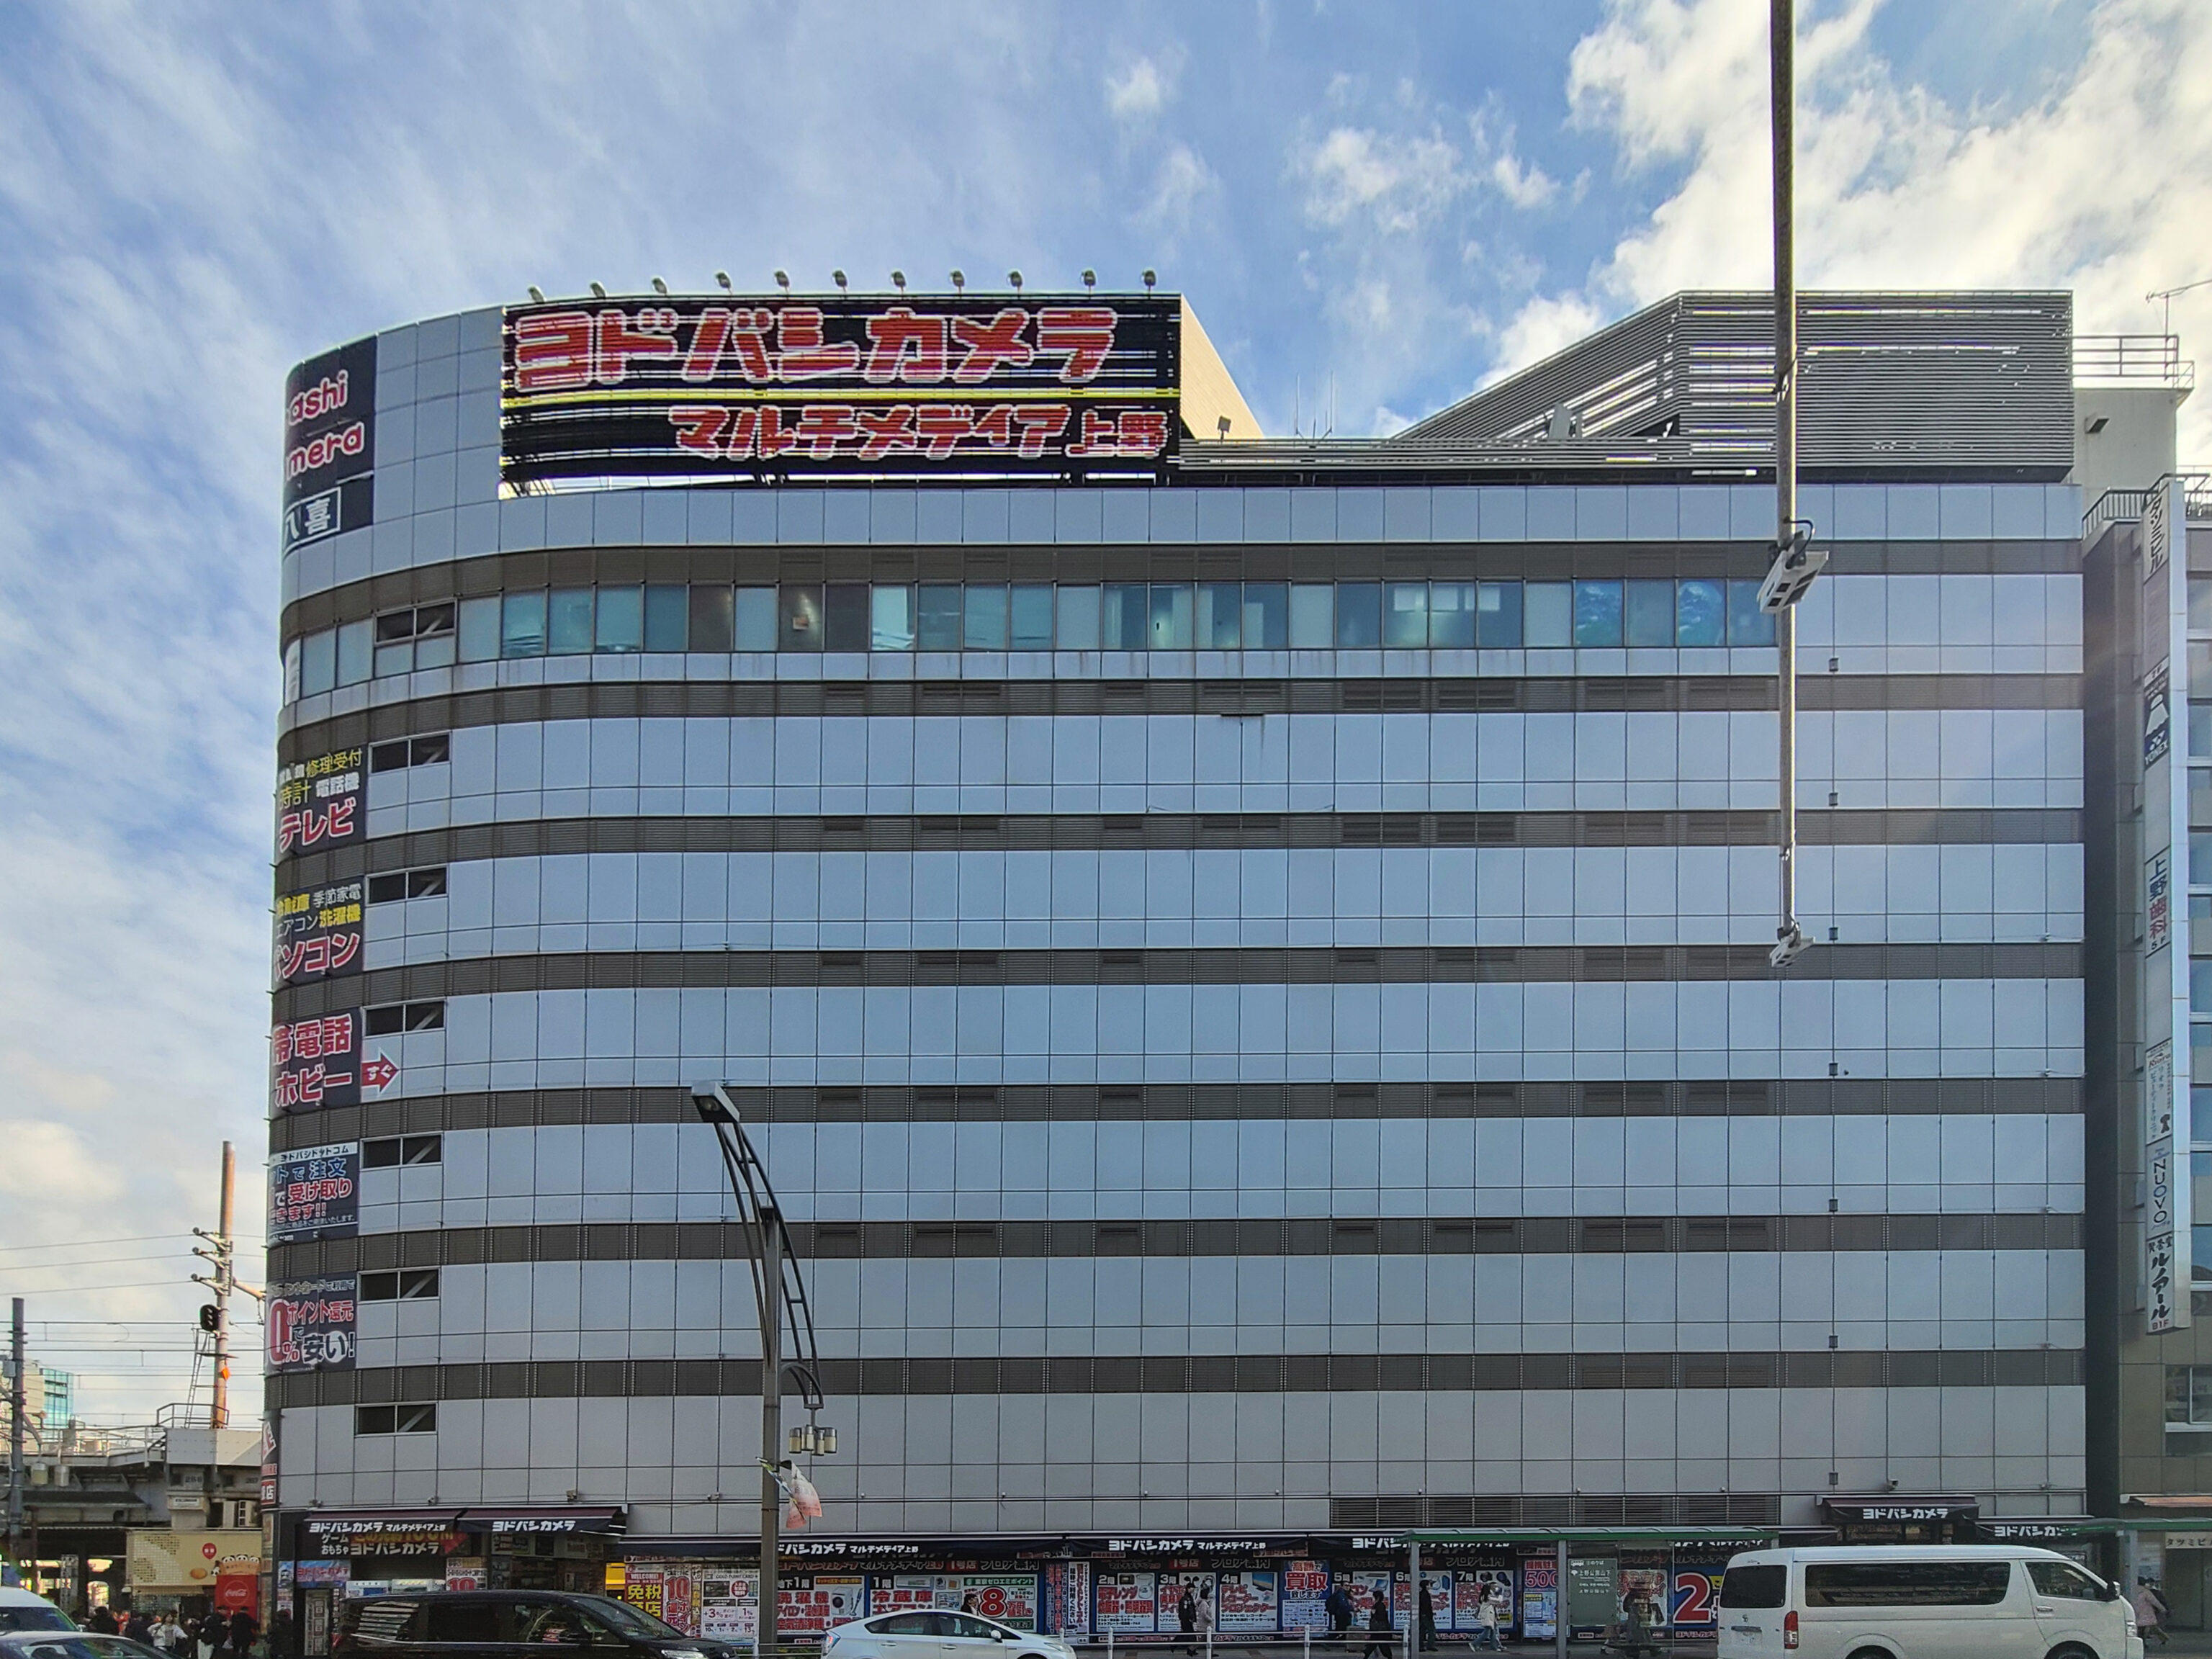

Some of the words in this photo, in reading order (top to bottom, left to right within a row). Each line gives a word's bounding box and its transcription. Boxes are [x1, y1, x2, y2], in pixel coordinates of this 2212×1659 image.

[515, 307, 1118, 392] ヨドバシカメラ
[2144, 739, 2169, 765] YONEX
[279, 796, 356, 854] テレビ
[366, 1064, 393, 1082] すぐ
[275, 1064, 353, 1107] ホビー
[280, 1145, 349, 1162] ヨドバシドットコム
[2154, 1158, 2167, 1224] NUOVO
[1863, 1508, 1948, 1519] ヨドバシカメラ
[309, 1521, 384, 1533] ヨドバシカメラ
[493, 1520, 576, 1532] ヨドバシカメラ
[321, 1533, 349, 1544] ゲーム
[1109, 1539, 1194, 1551] ヨドバシカメラ
[321, 1545, 349, 1555] おもちゃ
[350, 1542, 440, 1555] ヨドバシカメラ
[665, 1576, 691, 1601] 10
[1285, 1572, 1328, 1591] 買取
[627, 1584, 662, 1600] 免税
[1673, 1573, 1712, 1624] 2
[979, 1586, 1008, 1618] 8
